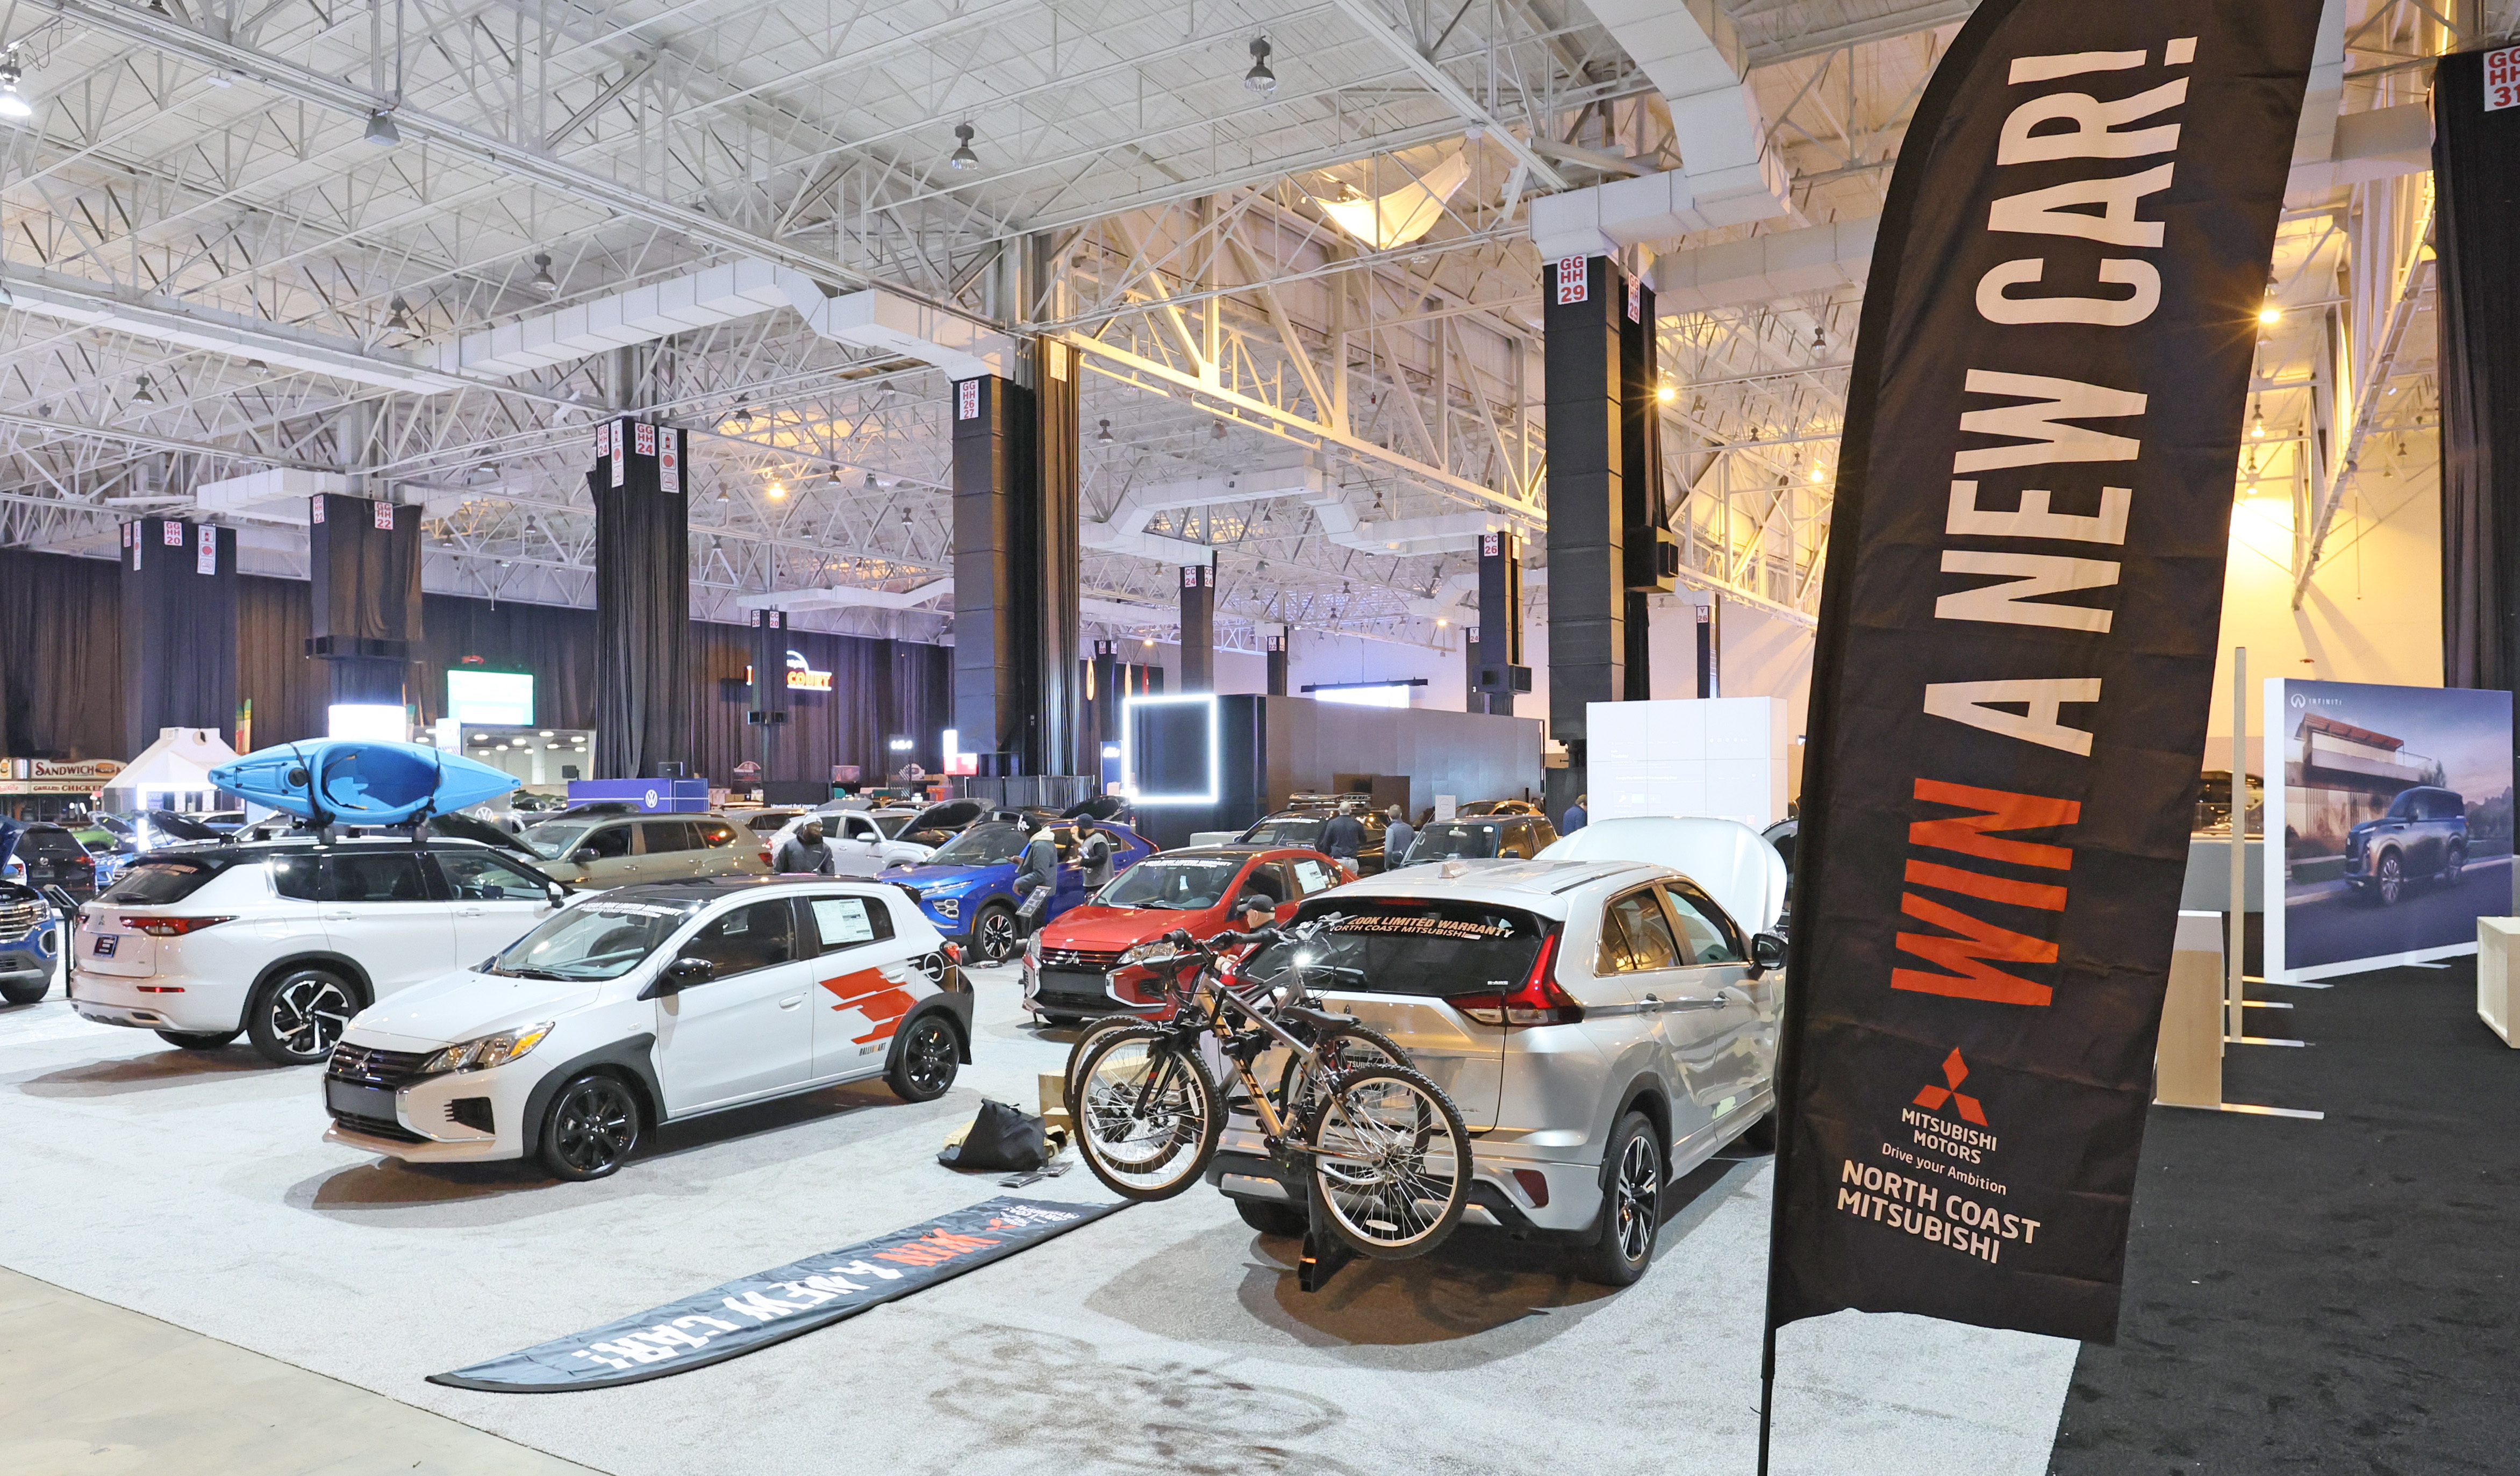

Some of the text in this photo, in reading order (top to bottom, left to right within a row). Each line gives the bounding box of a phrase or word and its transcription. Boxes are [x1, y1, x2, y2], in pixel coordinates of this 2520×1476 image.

[1560, 256, 1584, 270] GG
[1560, 269, 1583, 284] HH
[1630, 275, 1638, 290] GG
[1560, 285, 1585, 303] 29
[1630, 287, 1638, 304] HH
[1629, 303, 1638, 321] 29
[963, 381, 975, 391] GG
[963, 390, 975, 400] HH
[964, 399, 975, 409] 26
[964, 409, 975, 418] 27
[599, 426, 607, 435] GG
[638, 425, 653, 434] GG
[599, 435, 607, 443] HH
[638, 433, 653, 443] HH
[599, 445, 607, 456] 24
[638, 443, 653, 454] 24
[377, 503, 391, 511] GG
[315, 512, 323, 522] 22
[1891, 37, 2197, 1006] WIN A NEW CAR!
[377, 519, 391, 528] 22
[167, 536, 180, 544] 20
[1485, 546, 1497, 554] 26
[1185, 577, 1195, 585] 24
[788, 671, 831, 687] COURT
[2309, 698, 2342, 706] INFINITI
[35, 762, 94, 776] SANDWICH
[1364, 925, 1400, 933] COAST
[1400, 926, 1466, 938] MITSUBISHI
[1381, 916, 1436, 929] LIMITED
[1437, 920, 1515, 938] WARRANTY
[1902, 1107, 1998, 1152] MITSUBISHI
[1913, 1129, 1982, 1165] MOTORS
[1882, 1142, 2007, 1196] Drive your Ambition
[1842, 1159, 2041, 1244] NORTH COAST
[1837, 1187, 2000, 1264] MITSUBISHI
[571, 1227, 1001, 1370] WIN A NEW CAR!
